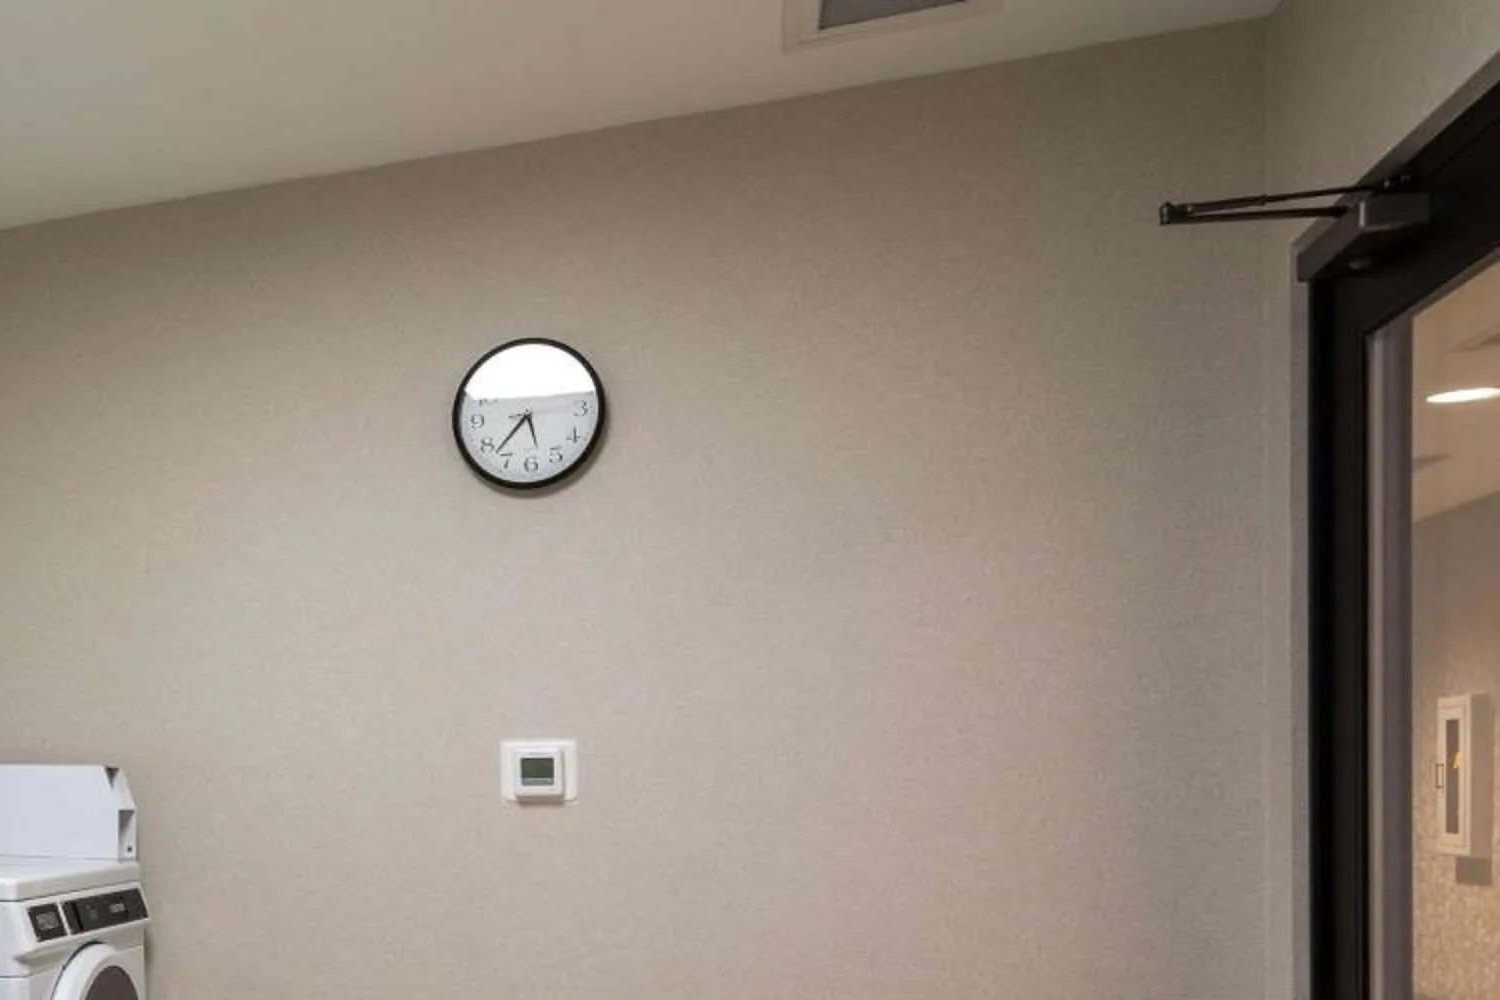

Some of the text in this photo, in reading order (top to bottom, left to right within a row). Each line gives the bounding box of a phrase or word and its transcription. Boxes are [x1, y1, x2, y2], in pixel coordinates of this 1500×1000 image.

[573, 400, 589, 417] 3
[470, 414, 485, 430] 9
[566, 426, 581, 444] 4
[479, 437, 495, 453] 8
[500, 451, 513, 469] 7
[548, 445, 564, 463] 5
[523, 456, 539, 473] 6
